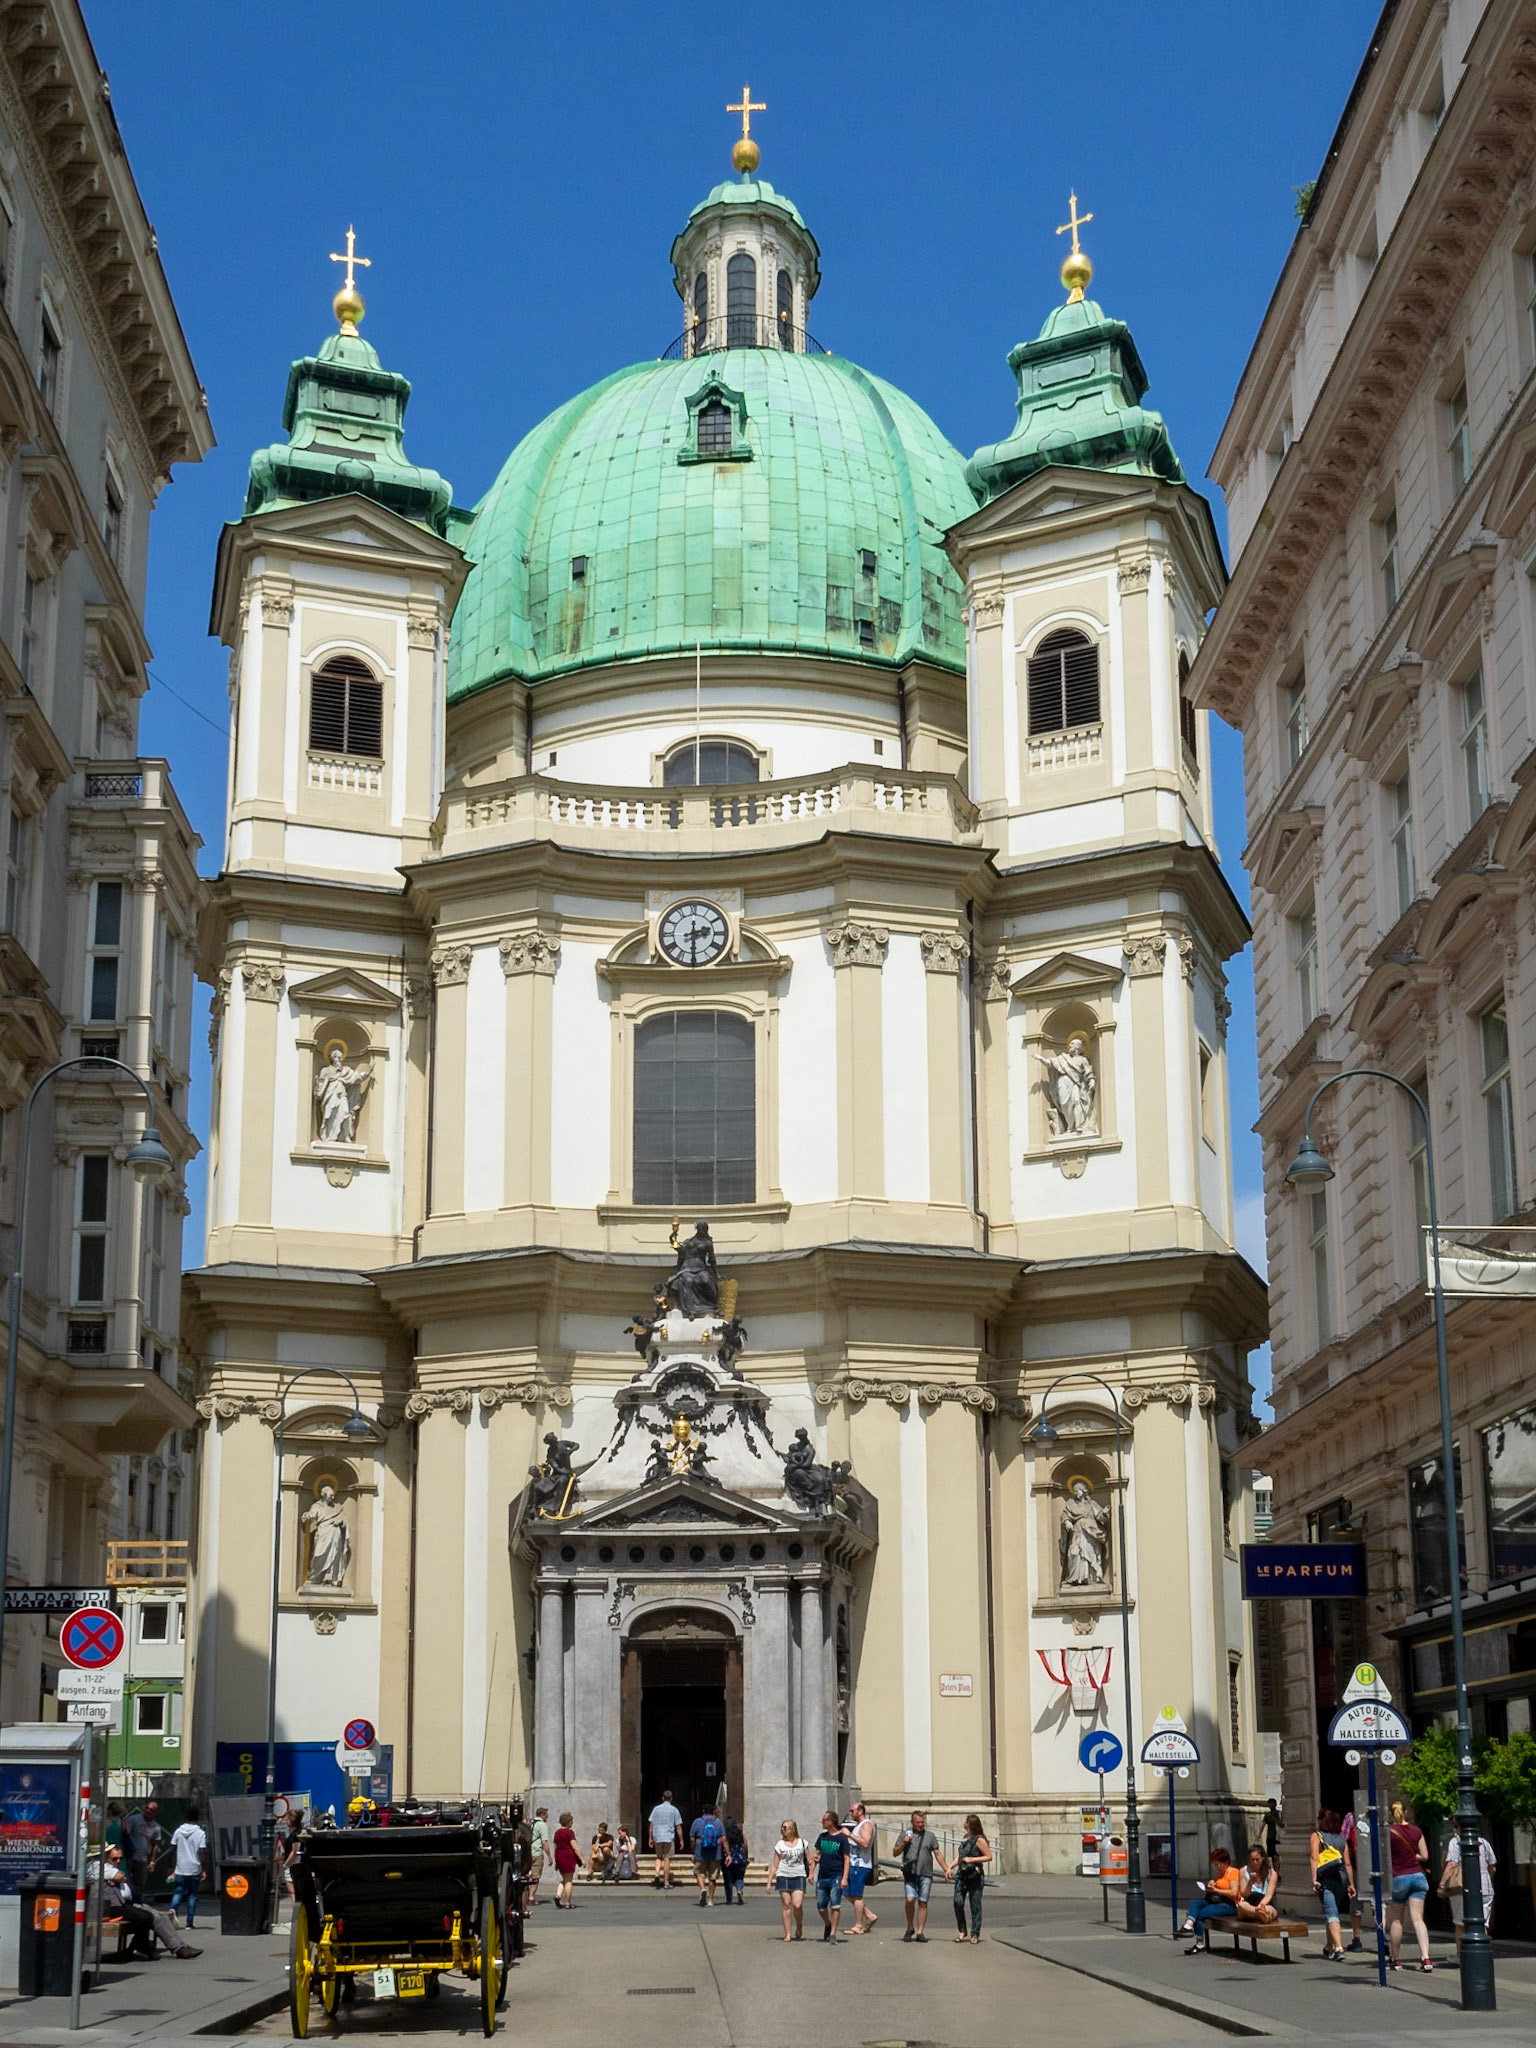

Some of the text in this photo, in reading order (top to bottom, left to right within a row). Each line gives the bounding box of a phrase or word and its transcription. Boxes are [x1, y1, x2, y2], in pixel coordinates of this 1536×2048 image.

[1257, 1565, 1353, 1577] LE PARFUM
[4, 1592, 107, 1608] NAPAPIJRI
[60, 1686, 121, 1695] ausgen. 2 Fiaker
[1347, 1706, 1392, 1722] AUTOBUS
[1340, 1729, 1400, 1739] HALTESTELLE
[1155, 1735, 1187, 1748] AUTOBUS
[1149, 1751, 1192, 1759] HALTESTELLE
[7, 1839, 40, 1847] WIENER
[0, 1846, 63, 1854] LHARMONIKER
[378, 1974, 391, 1984] 51
[400, 1975, 423, 1989] F170
